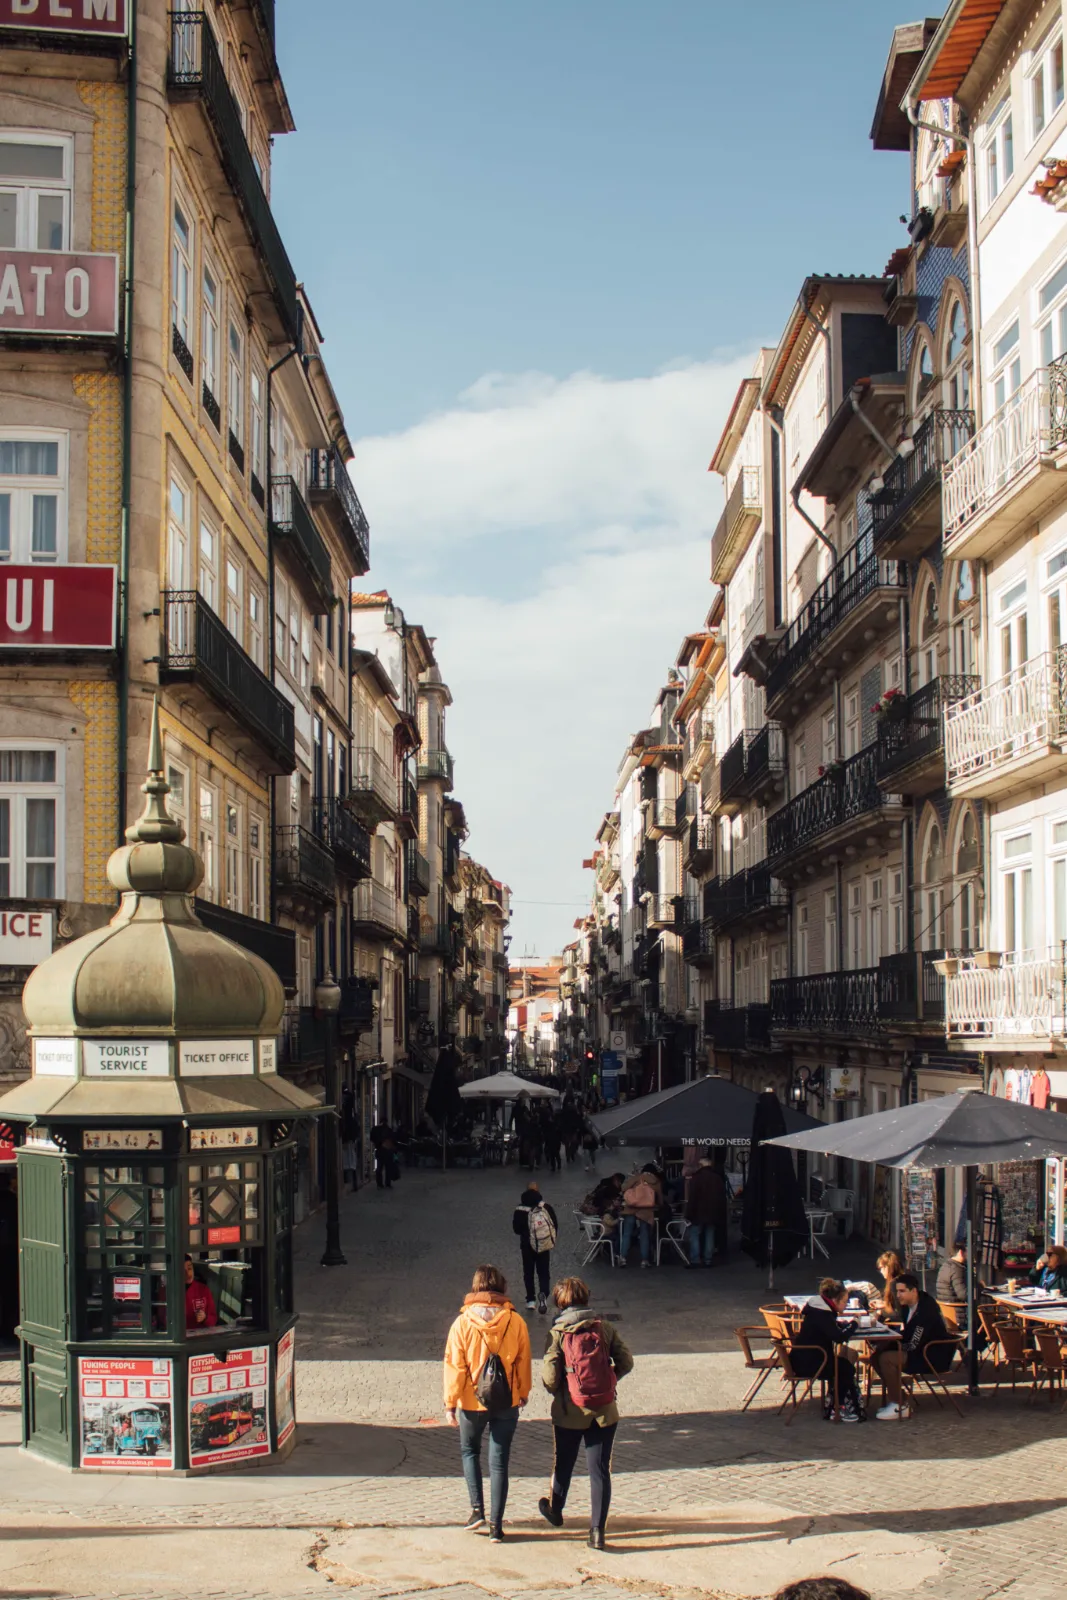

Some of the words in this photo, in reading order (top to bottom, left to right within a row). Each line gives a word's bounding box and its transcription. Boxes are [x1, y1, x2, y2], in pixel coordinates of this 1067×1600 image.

[0, 264, 90, 318] ATO
[6, 578, 54, 632] UI
[2, 913, 42, 937] ICE
[98, 1045, 149, 1057] TOURIST
[184, 1053, 217, 1063] TICKET
[219, 1052, 250, 1062] OFFICE
[100, 1060, 148, 1071] SERVICE
[681, 1137, 695, 1146] THE
[696, 1137, 725, 1146] WORLD
[726, 1137, 751, 1146] NEEDS
[83, 1361, 108, 1369] TUKING
[110, 1361, 136, 1370] PEOPLE
